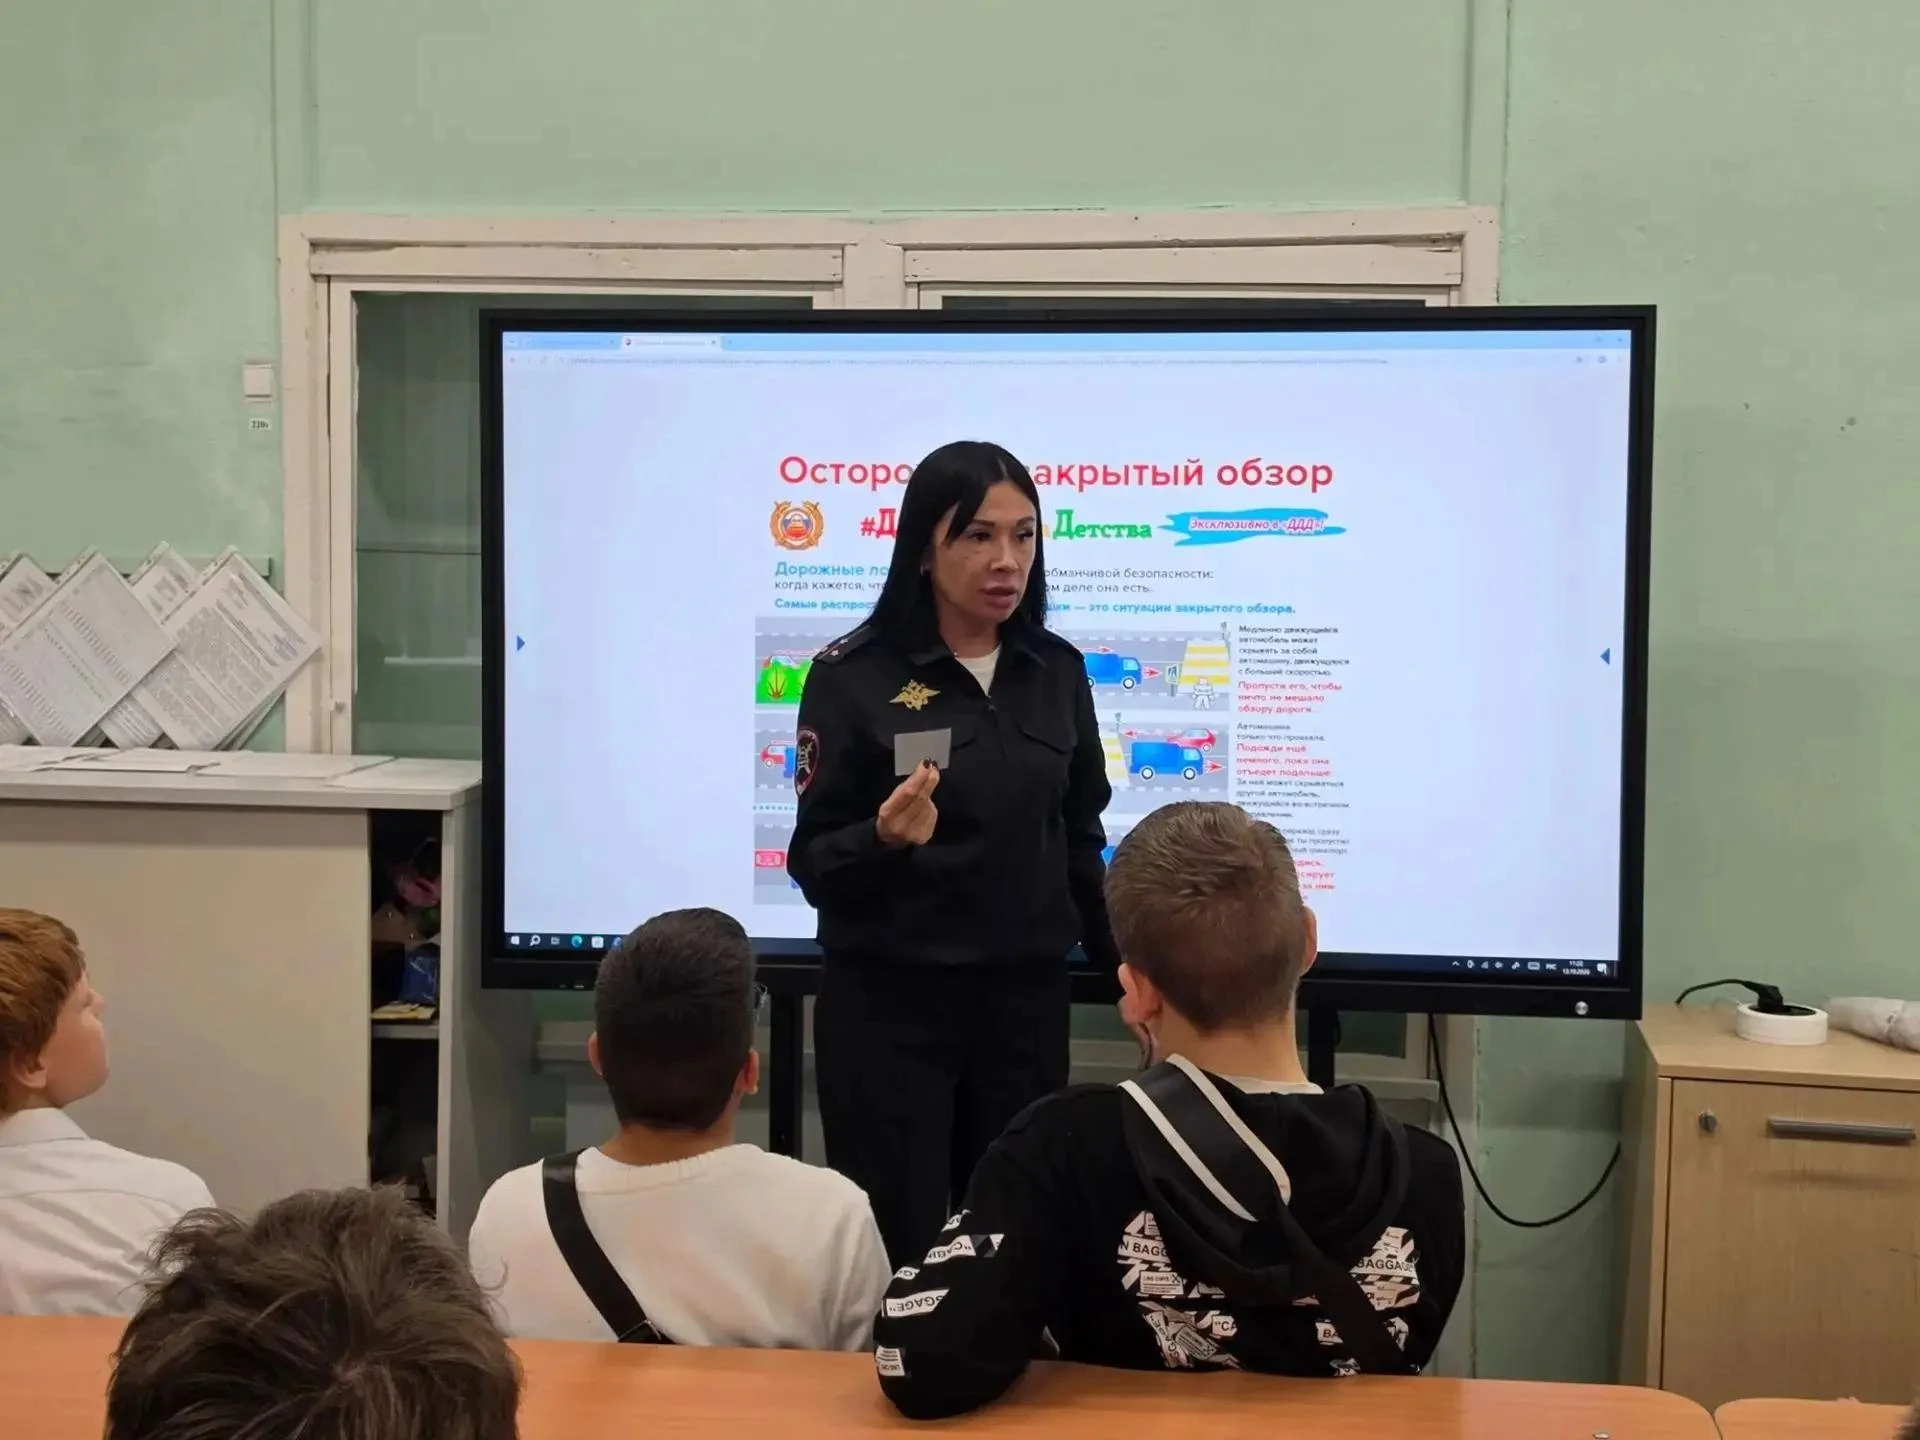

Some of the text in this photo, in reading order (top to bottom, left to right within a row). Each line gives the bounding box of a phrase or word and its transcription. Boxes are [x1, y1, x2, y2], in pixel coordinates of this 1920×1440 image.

[779, 456, 1333, 493] Осторо акрытый обзор
[1052, 509, 1152, 540] Детства
[1191, 519, 1269, 530] Эксклюзивно
[1272, 521, 1279, 530] в
[775, 561, 864, 578] Дорожные
[1044, 567, 1120, 578] обманчивой
[1124, 568, 1214, 580] безопасности:
[775, 582, 808, 590] когда
[812, 582, 864, 591] кажется,
[1045, 584, 1060, 593] ом
[1063, 585, 1093, 594] деле
[1097, 585, 1119, 593] она
[775, 598, 817, 609] Самые
[821, 602, 876, 612] распрос
[1047, 603, 1070, 612] шки
[1089, 604, 1109, 612] это
[1112, 604, 1171, 614] ситуации
[1175, 603, 1242, 616] закрытого
[1247, 603, 1295, 616] обзора.
[1292, 647, 1318, 655] собой
[1238, 681, 1286, 691] Пропусти
[1311, 683, 1342, 691] чтобы
[1284, 695, 1324, 703] мешало
[1238, 705, 1272, 714] обзору
